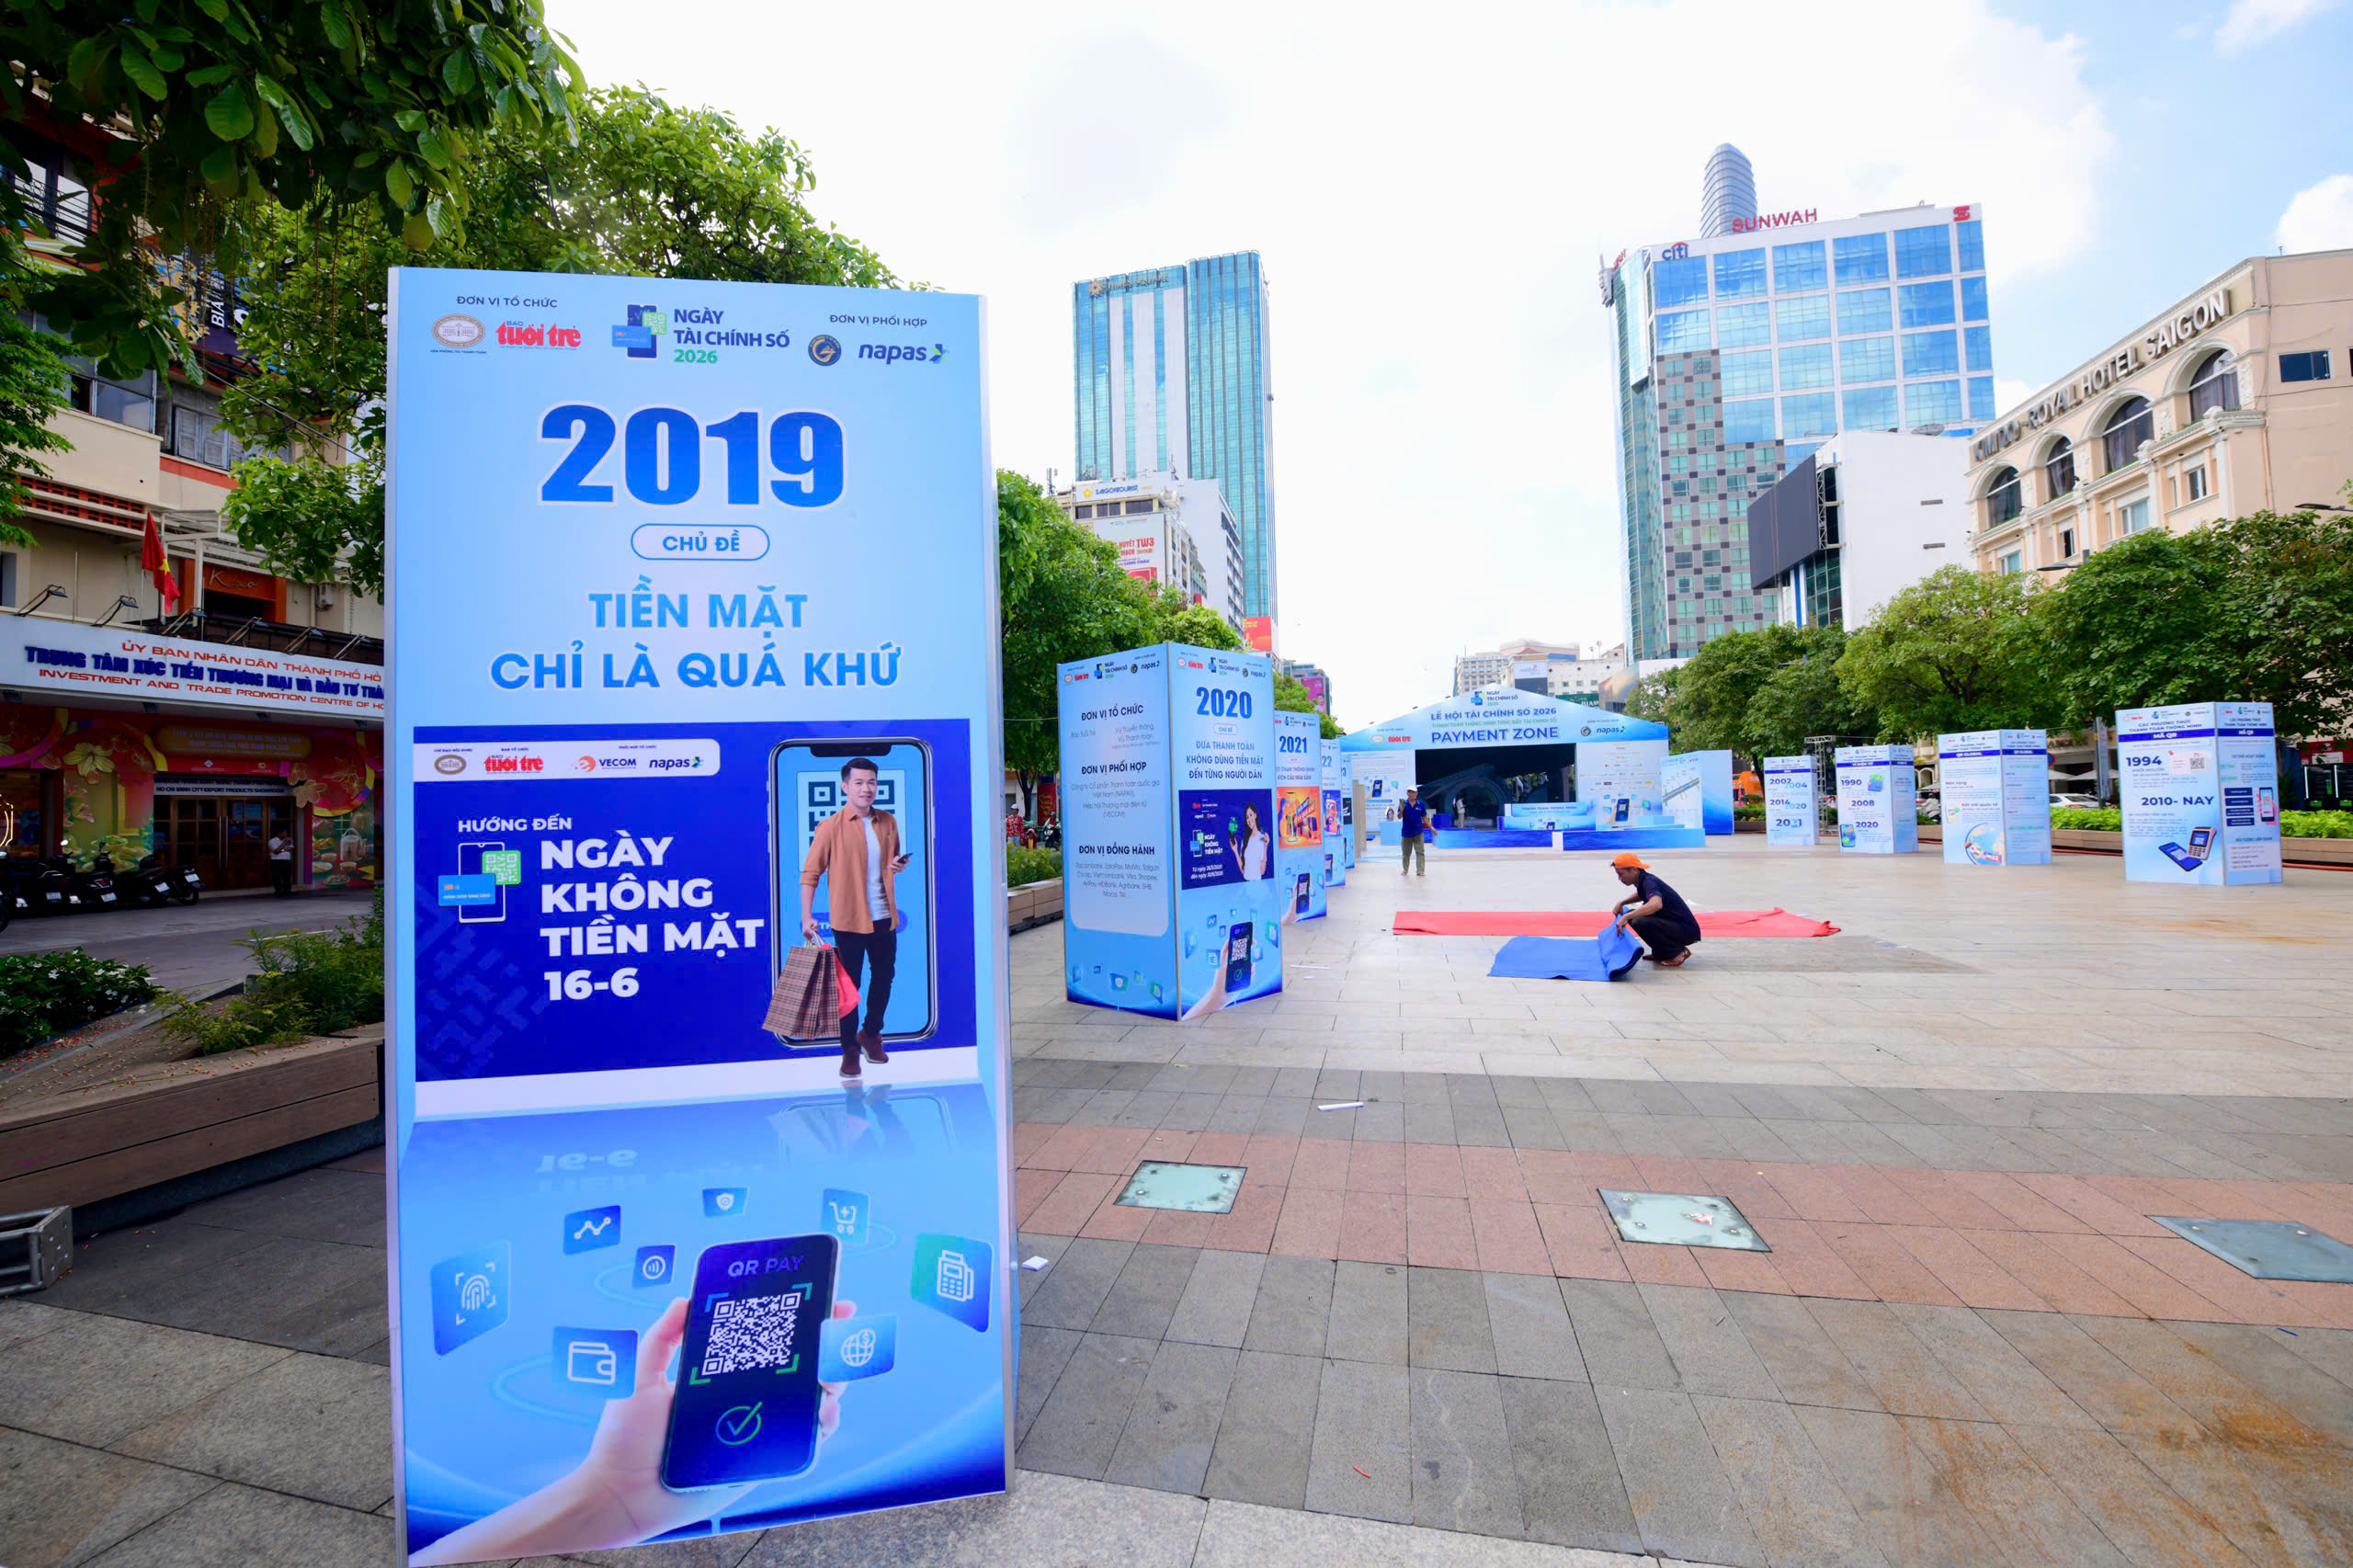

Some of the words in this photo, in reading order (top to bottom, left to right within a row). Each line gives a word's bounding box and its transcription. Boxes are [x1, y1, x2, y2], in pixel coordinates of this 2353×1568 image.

[1732, 208, 1818, 233] SUNWAH
[1661, 242, 1689, 261] citi
[456, 295, 484, 305] ĐƠN
[488, 298, 500, 308] VỊ
[503, 295, 519, 307] TỔ
[523, 297, 558, 308] CHỨC
[210, 301, 225, 329] BIA
[673, 306, 724, 324] NGÀY
[829, 314, 856, 324] ĐƠN
[858, 315, 870, 326] VỊ
[872, 313, 900, 326] PHỐI
[903, 316, 927, 328] HỢP
[673, 328, 702, 345] TÀI
[704, 328, 763, 347] CHÍNH
[765, 328, 790, 348] SỐ
[673, 348, 719, 364] 2026
[858, 343, 927, 365] napas
[2028, 383, 2082, 430] ROYAL
[2080, 345, 2144, 396] HOTEL
[2146, 289, 2231, 358] SAIGON
[540, 403, 845, 508] 2019
[1095, 485, 1139, 495] SAIGONTOURIST
[662, 530, 708, 552] CHỦ
[714, 528, 741, 553] ĐỀ
[1136, 537, 1155, 549] TW3
[588, 574, 689, 630] TIỀN
[708, 585, 809, 638] MẶT
[121, 639, 147, 653] ỦY
[152, 646, 189, 659] BAN
[194, 651, 242, 665] NHÂN
[244, 657, 278, 670] DÂN
[283, 662, 332, 677] THÀNH
[335, 668, 361, 681] PHỐ
[363, 671, 382, 683] HỒ
[491, 639, 585, 689] CHỈ
[602, 643, 662, 688] LÀ
[676, 643, 788, 688] QUÁ
[803, 641, 902, 687] KHỨ
[25, 645, 86, 668] TRUNG
[92, 653, 129, 673] TÂM
[133, 657, 166, 676] XÚC
[170, 661, 204, 680] TIẾN
[207, 666, 264, 687] THƯƠNG
[267, 675, 292, 692] MẠI
[296, 676, 313, 692] VÀ
[343, 683, 359, 697] TƯ
[361, 684, 384, 700] THÀ
[40, 668, 142, 687] INVESTMENT
[146, 679, 179, 689] AND
[187, 683, 232, 696] TRADE
[236, 688, 307, 702] PROMOTION
[310, 696, 353, 707] CENTRE
[1081, 709, 1097, 722] ĐƠN
[1099, 710, 1108, 721] VỊ
[1108, 702, 1119, 718] TỔ
[1121, 702, 1143, 716] CHỨC
[1196, 686, 1253, 720] 2020
[1430, 710, 1442, 721] LỄ
[1445, 711, 1462, 722] HỘI
[1465, 710, 1481, 719] TÀI
[1483, 708, 1515, 718] CHÍNH
[1517, 706, 1530, 716] SỐ
[1533, 708, 1557, 716] 2026
[1431, 728, 1508, 744] PAYMENT
[1513, 727, 1560, 740] ZONE
[1596, 726, 1620, 734] napas
[1212, 741, 1235, 750] THANH
[1237, 738, 1255, 751] TOÁN
[1279, 735, 1307, 754] 2021
[599, 757, 637, 767] VECOM
[649, 756, 690, 771] napas
[1081, 765, 1097, 775] ĐƠN
[1099, 765, 1108, 776] VỊ
[1108, 759, 1128, 773] PHỐI
[1130, 761, 1147, 775] HỢP
[1186, 754, 1212, 765] KHÔNG
[1214, 754, 1234, 765] DÙNG
[1236, 753, 1249, 766] TIỀN
[1250, 754, 1264, 767] MẶT
[2125, 756, 2163, 767] 1994
[1188, 767, 1203, 778] ĐẾN
[1205, 768, 1223, 779] TỪNG
[1224, 767, 1247, 779] NGƯỜI
[1248, 768, 1262, 779] DÂN
[1840, 778, 1862, 787] 1990
[2182, 795, 2214, 806] NAY
[458, 814, 528, 834] HƯỚNG
[532, 813, 573, 833] ĐẾN
[540, 830, 674, 870] NGÀY
[1079, 844, 1095, 854] ĐƠN
[1097, 845, 1105, 857] VỊ
[1107, 841, 1130, 855] ĐỒNG
[1132, 843, 1155, 855] HÀNH
[540, 873, 713, 914] KHÔNG
[540, 916, 648, 957] TIỀN
[664, 912, 765, 959] MẶT
[543, 966, 640, 1001] 16-6
[727, 1259, 759, 1277] QR
[765, 1256, 804, 1273] PAY
